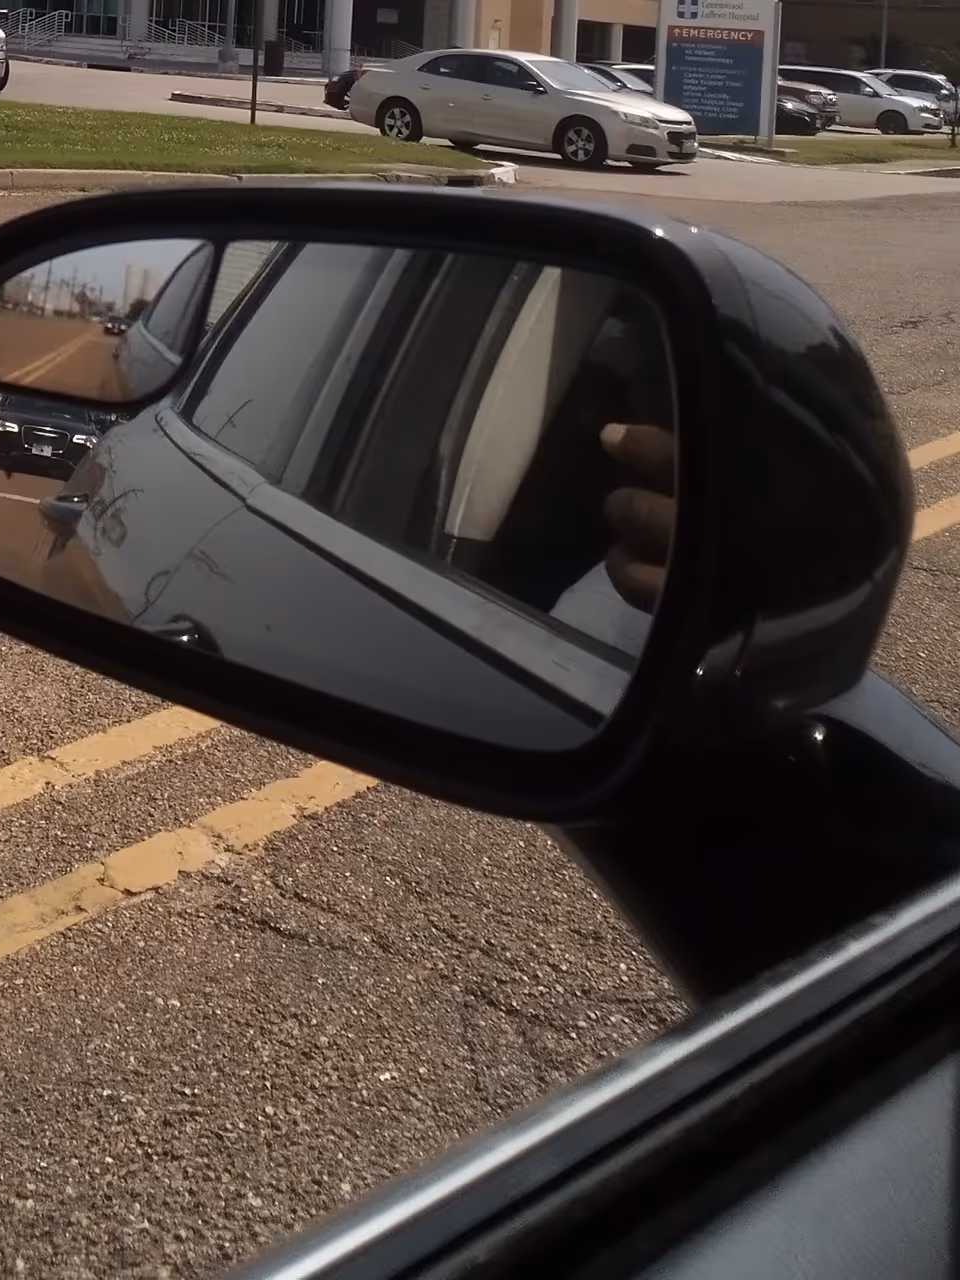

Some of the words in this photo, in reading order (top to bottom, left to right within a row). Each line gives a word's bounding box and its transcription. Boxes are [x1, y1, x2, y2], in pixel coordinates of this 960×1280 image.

[701, 0, 744, 10] Greenwood
[728, 12, 759, 21] Hospital
[682, 28, 753, 40] EMERGENCY
